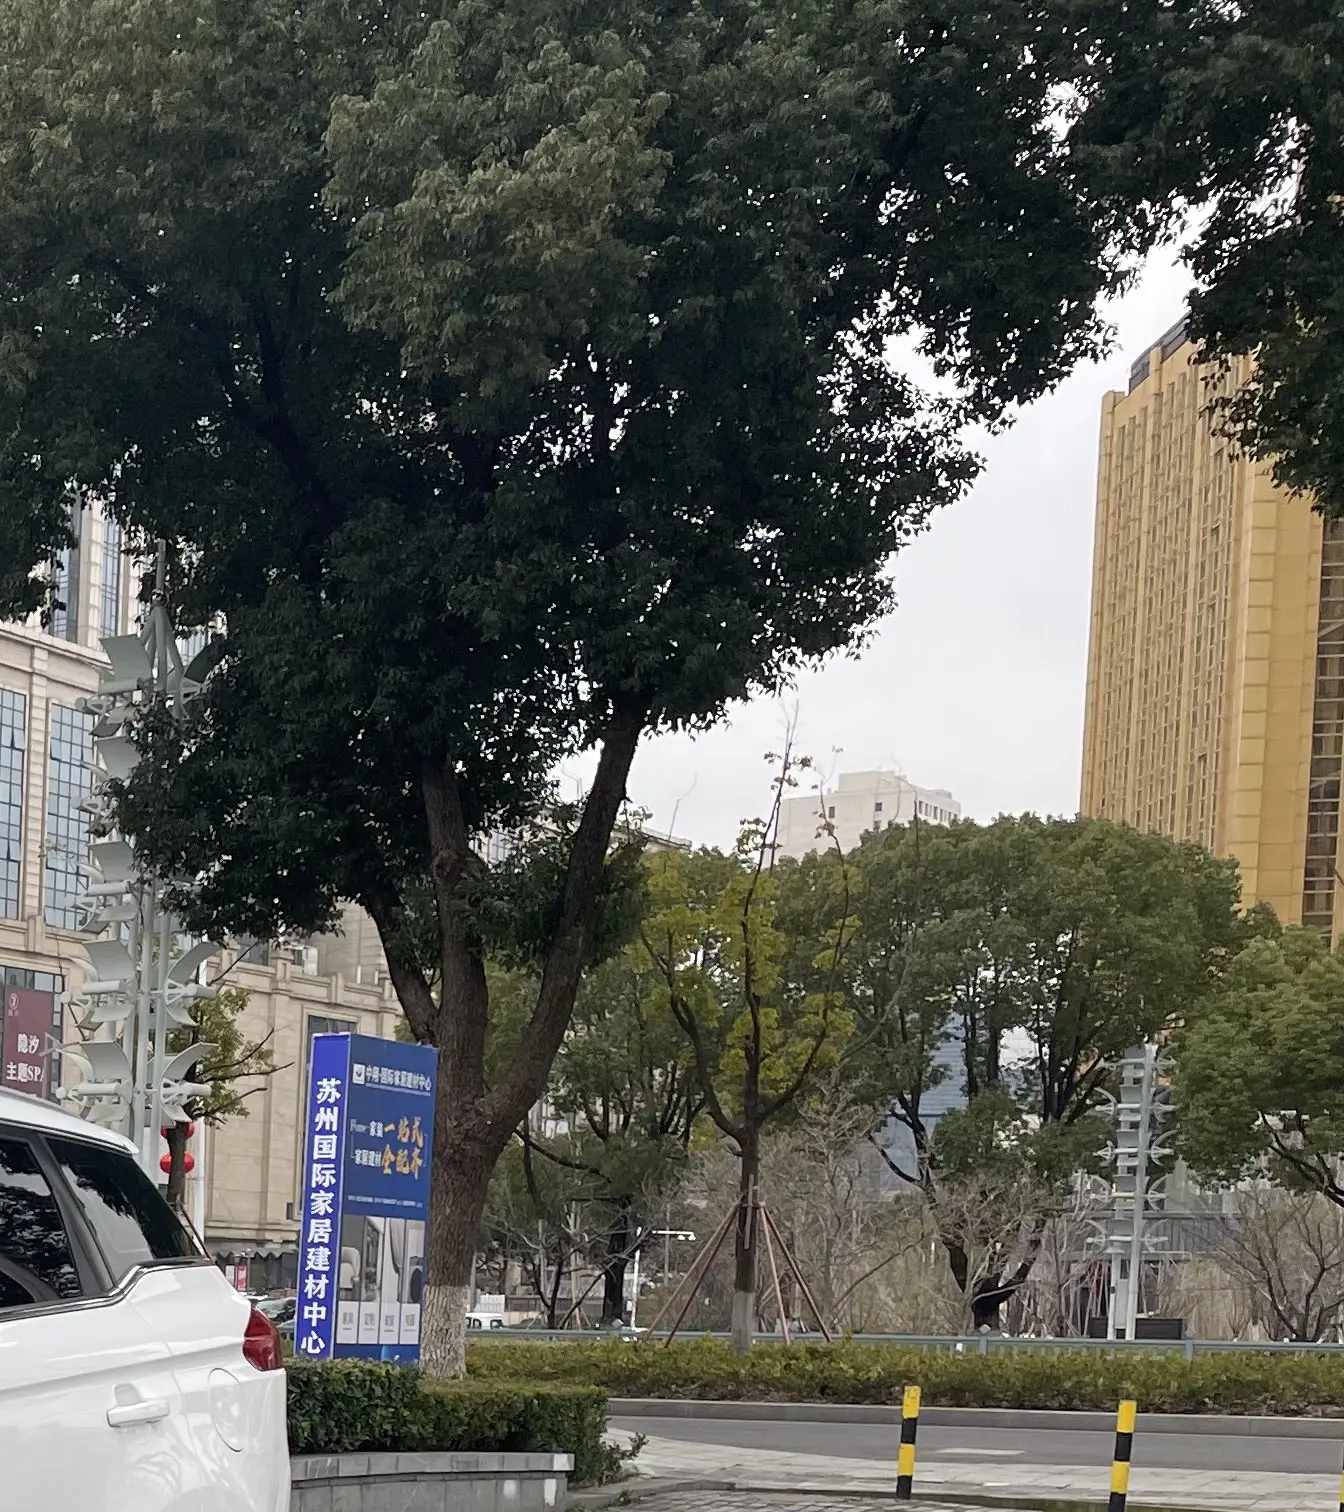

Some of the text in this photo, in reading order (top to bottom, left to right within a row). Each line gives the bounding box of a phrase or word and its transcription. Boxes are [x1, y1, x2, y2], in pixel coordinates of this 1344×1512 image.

[300, 1077, 342, 1356] 苏州国际家居建材中心
